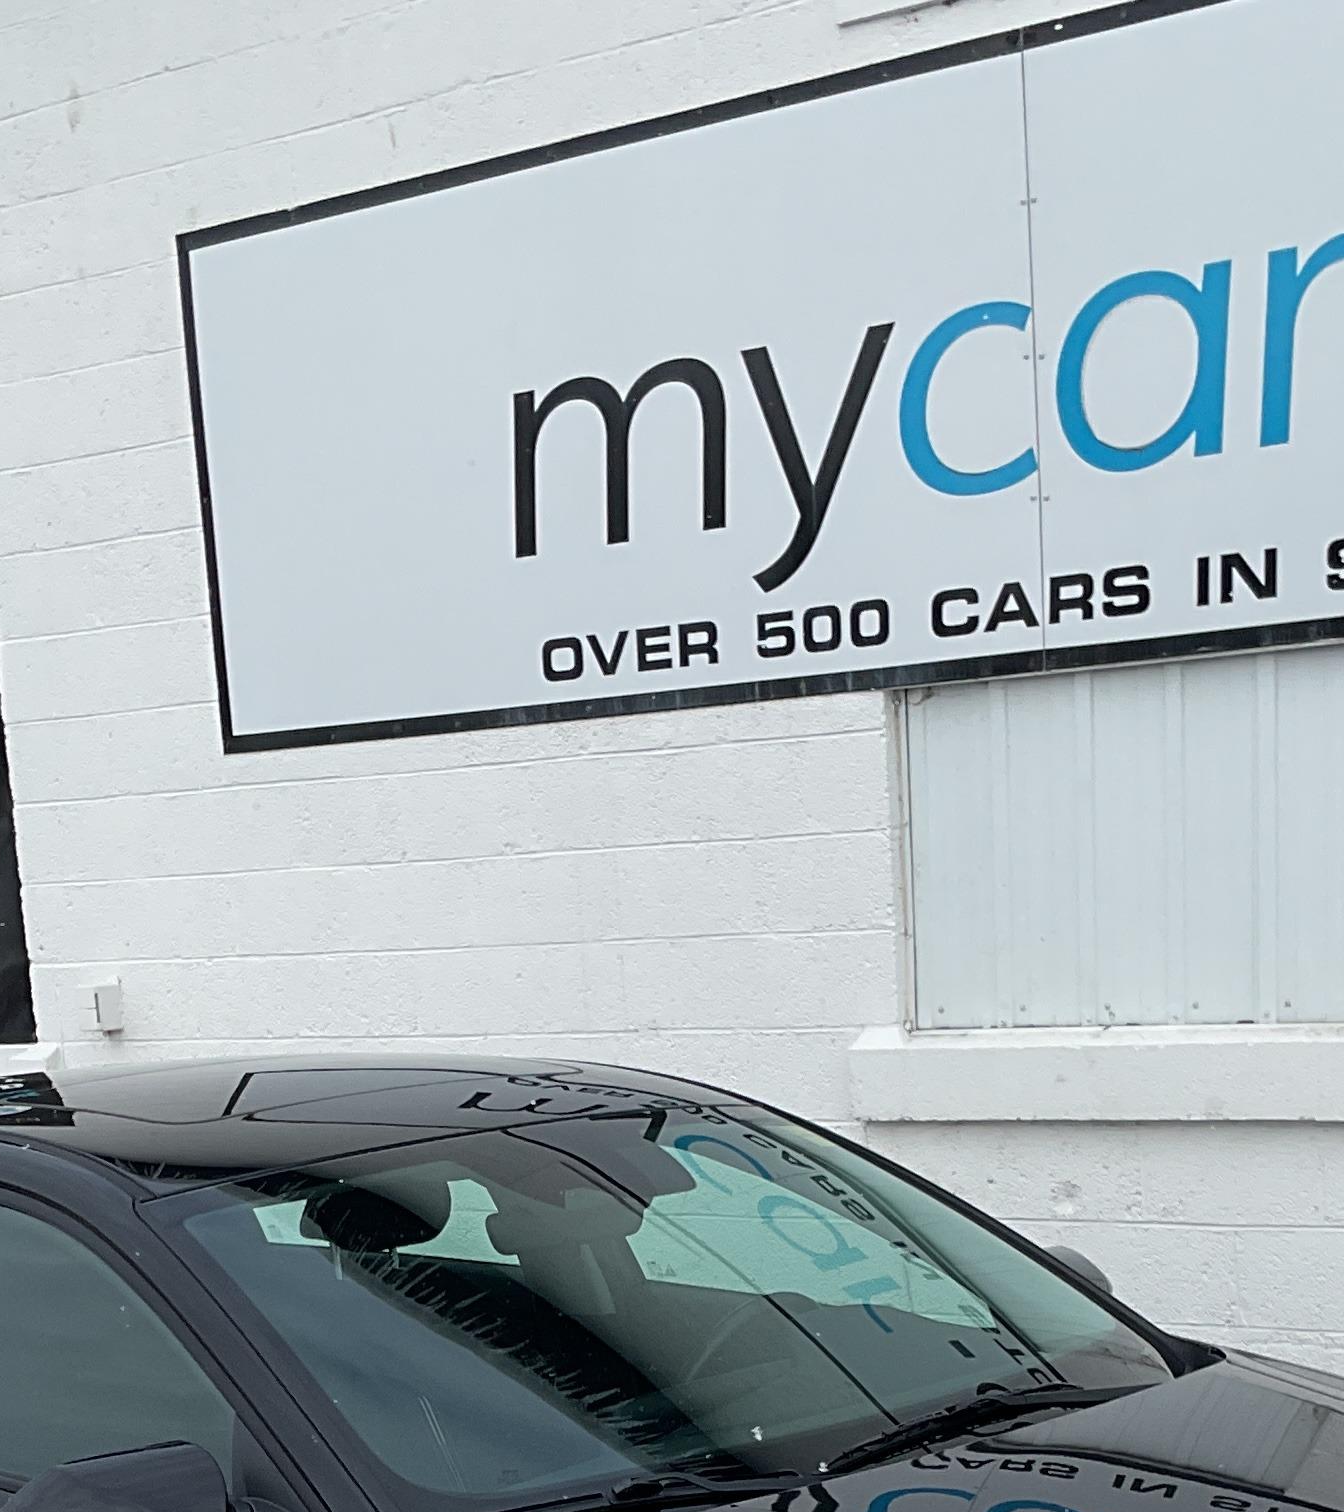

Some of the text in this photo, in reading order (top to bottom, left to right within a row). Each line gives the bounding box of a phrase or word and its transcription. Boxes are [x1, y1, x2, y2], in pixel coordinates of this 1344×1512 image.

[541, 620, 719, 682] OVER
[756, 598, 890, 659] 500
[931, 564, 1151, 638] CARS
[1196, 547, 1278, 607] IN
